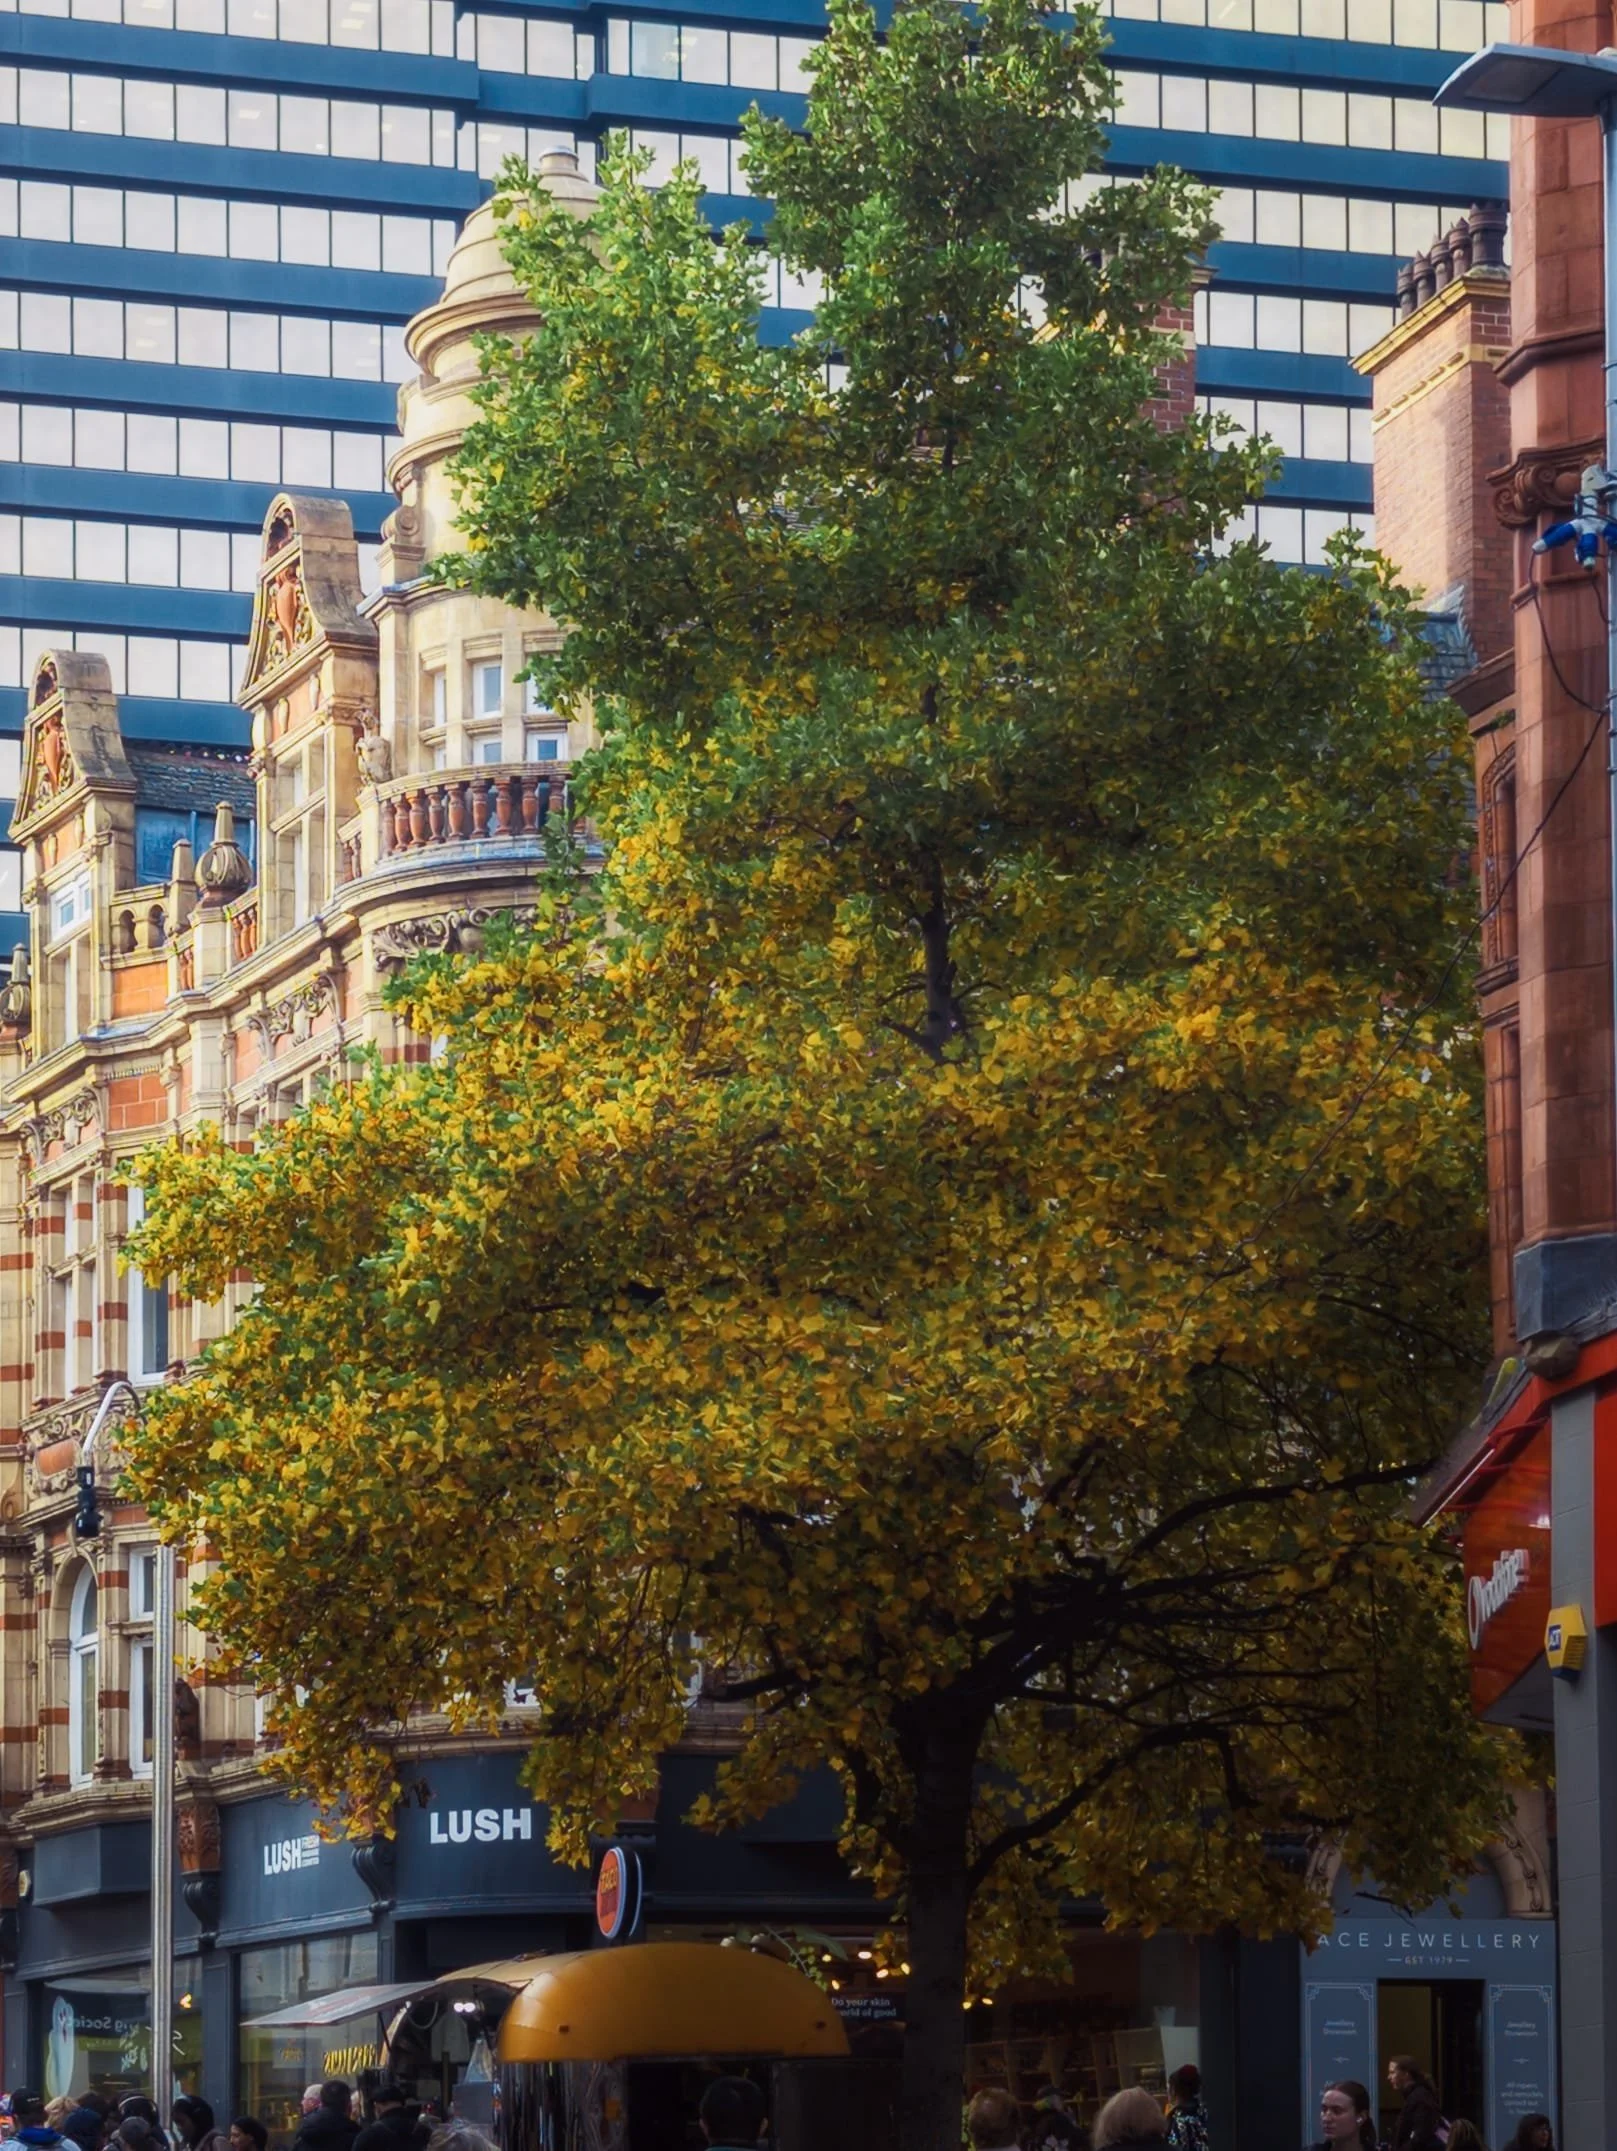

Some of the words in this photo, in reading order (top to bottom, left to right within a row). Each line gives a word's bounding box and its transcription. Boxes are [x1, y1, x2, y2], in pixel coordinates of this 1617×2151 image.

[429, 1807, 532, 1844] LUSH
[264, 1838, 301, 1875] LUSH
[1317, 1931, 1369, 1948] ACE
[1384, 1932, 1540, 1949] JEWELLERY
[846, 1998, 868, 2008] your
